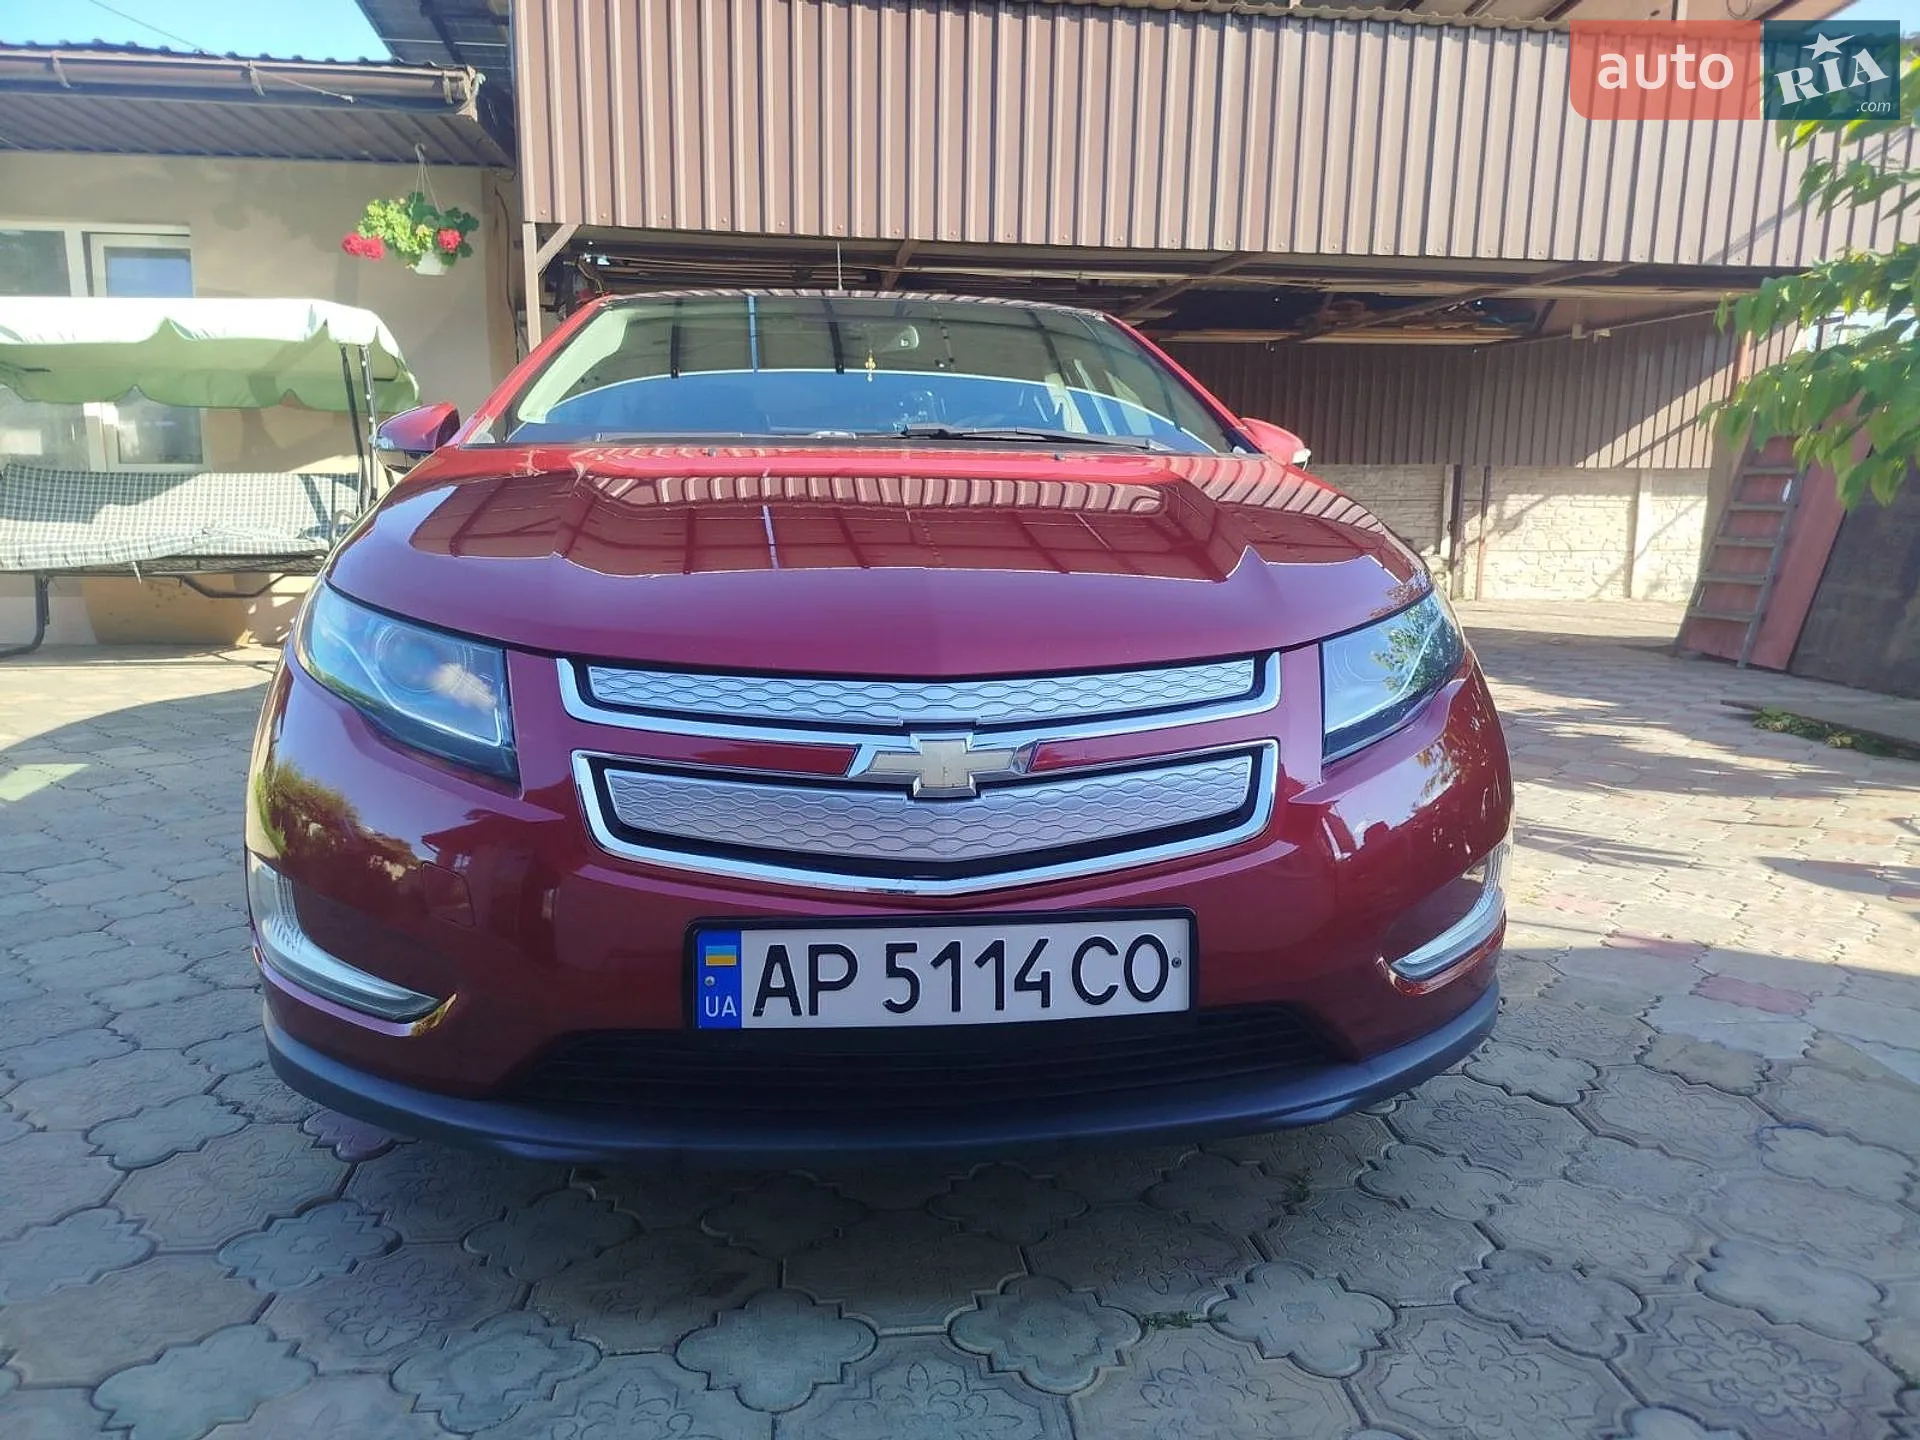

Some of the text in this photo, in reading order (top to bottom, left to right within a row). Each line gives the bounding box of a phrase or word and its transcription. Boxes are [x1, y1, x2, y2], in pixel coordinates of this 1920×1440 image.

[752, 933, 1170, 1017] AP 5114 CO
[705, 995, 737, 1018] UA
